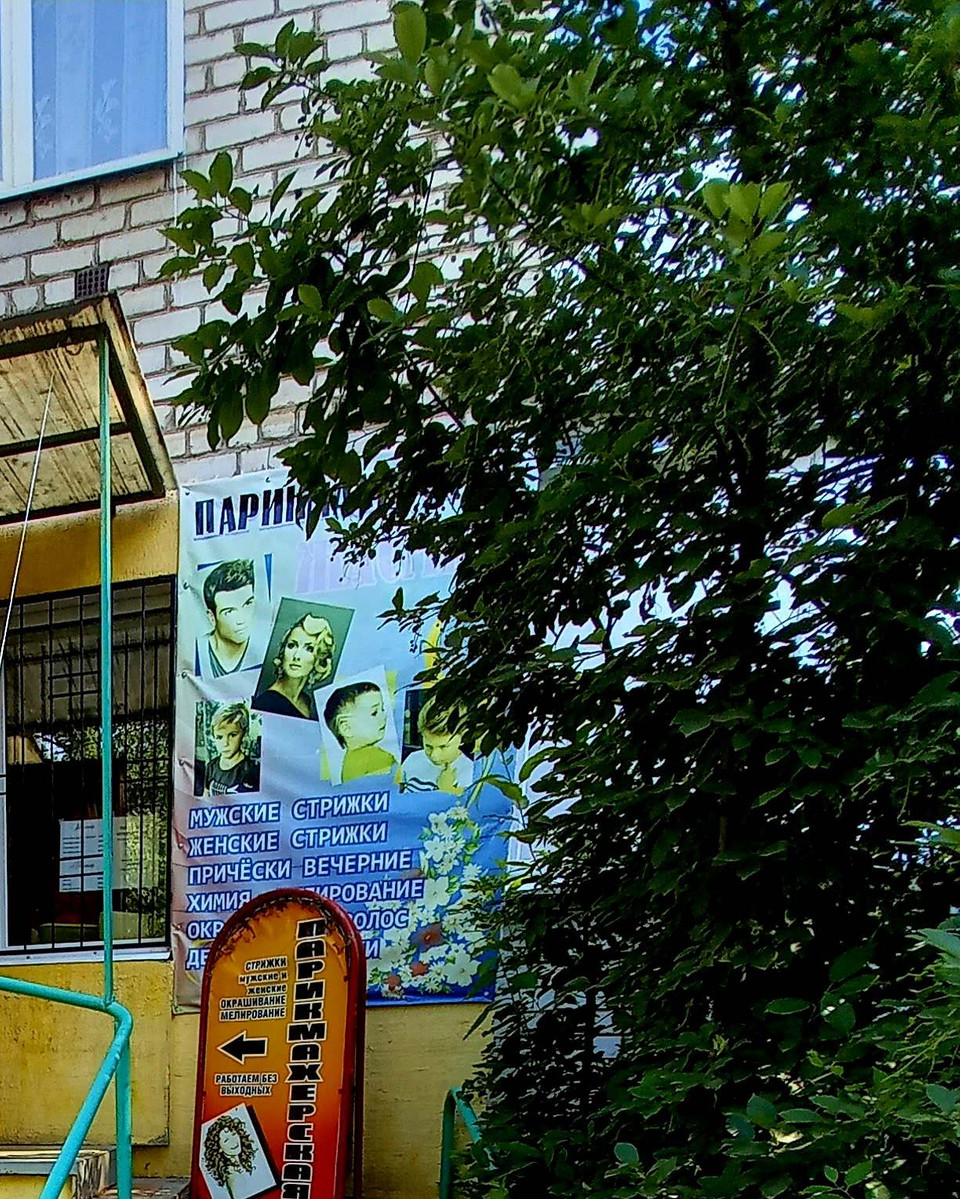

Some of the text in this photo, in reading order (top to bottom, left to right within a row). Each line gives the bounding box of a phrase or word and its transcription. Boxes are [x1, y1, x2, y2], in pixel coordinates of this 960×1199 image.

[189, 790, 390, 829] МУЖСКИЕ СТРИЖКИ
[188, 822, 388, 857] ЖЕНСКИЕ СТРИЖКИ
[188, 849, 412, 885] ПРИЧЁСКИ ВЕЧЕРНИЕ
[187, 890, 251, 912] ХИМИЯ
[350, 909, 408, 930] ОЛОС
[245, 957, 287, 971] СТРИЖКИ
[220, 995, 286, 1009] ОКРАШИВАНИЕ
[220, 1008, 285, 1020] МЕЛИРОВАНИЕ
[215, 1073, 277, 1083] РАБОТАЕМ БЕЗ
[221, 1086, 270, 1096] ВЫХОДНЫХ
